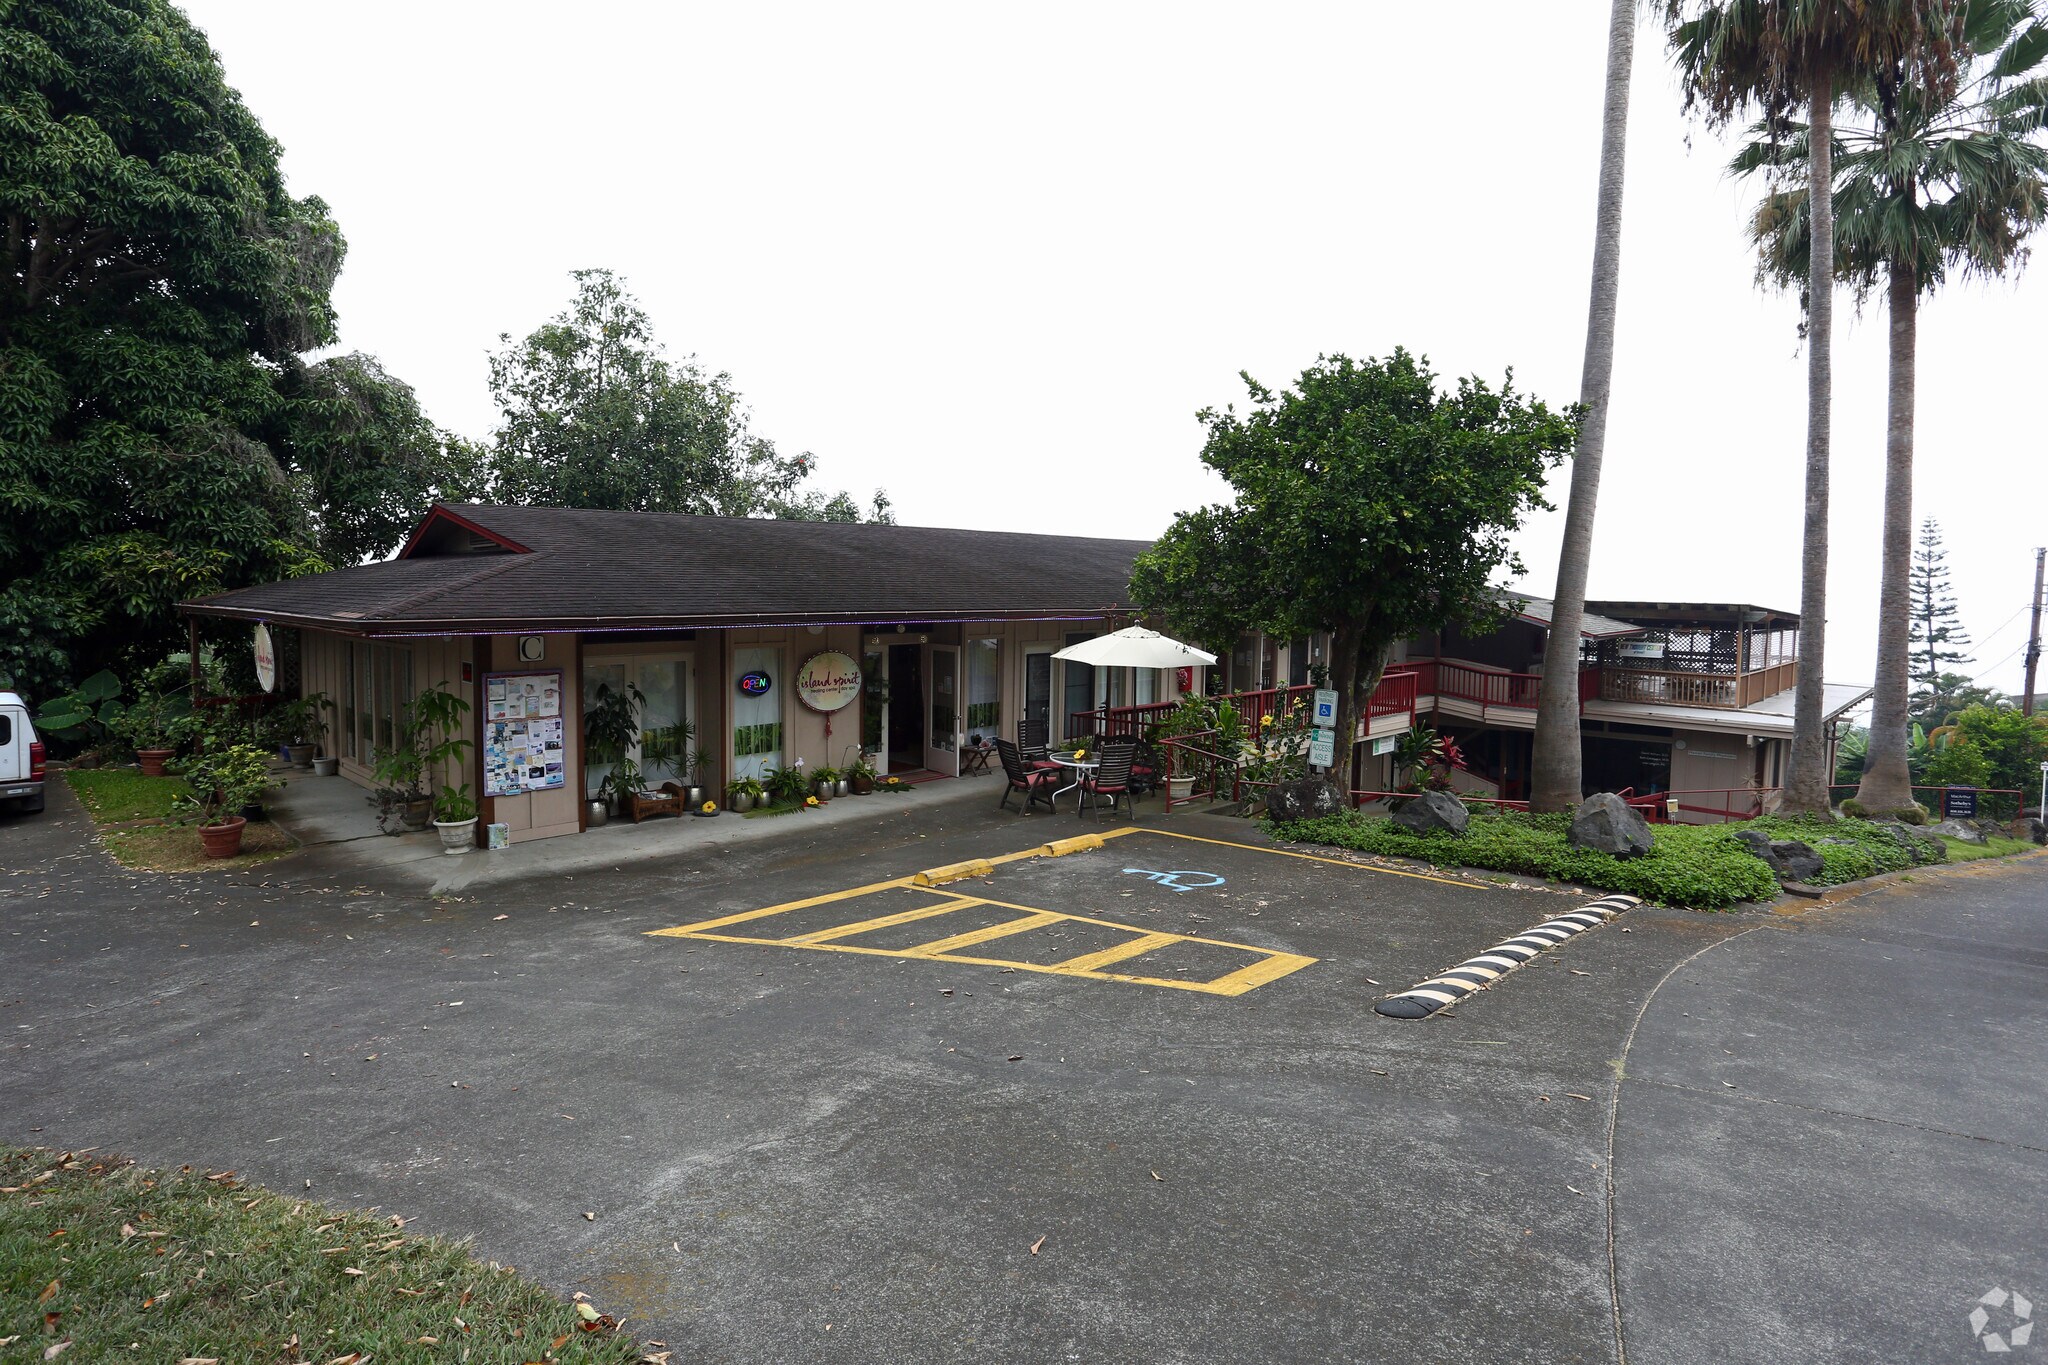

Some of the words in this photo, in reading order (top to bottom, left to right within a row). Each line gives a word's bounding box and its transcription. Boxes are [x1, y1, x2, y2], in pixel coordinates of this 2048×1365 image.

[521, 636, 542, 660] C
[743, 677, 766, 689] OPEN
[801, 670, 832, 689] island
[833, 671, 860, 693] spirit
[1313, 743, 1332, 752] ACCESS
[1314, 753, 1328, 761] AISLE
